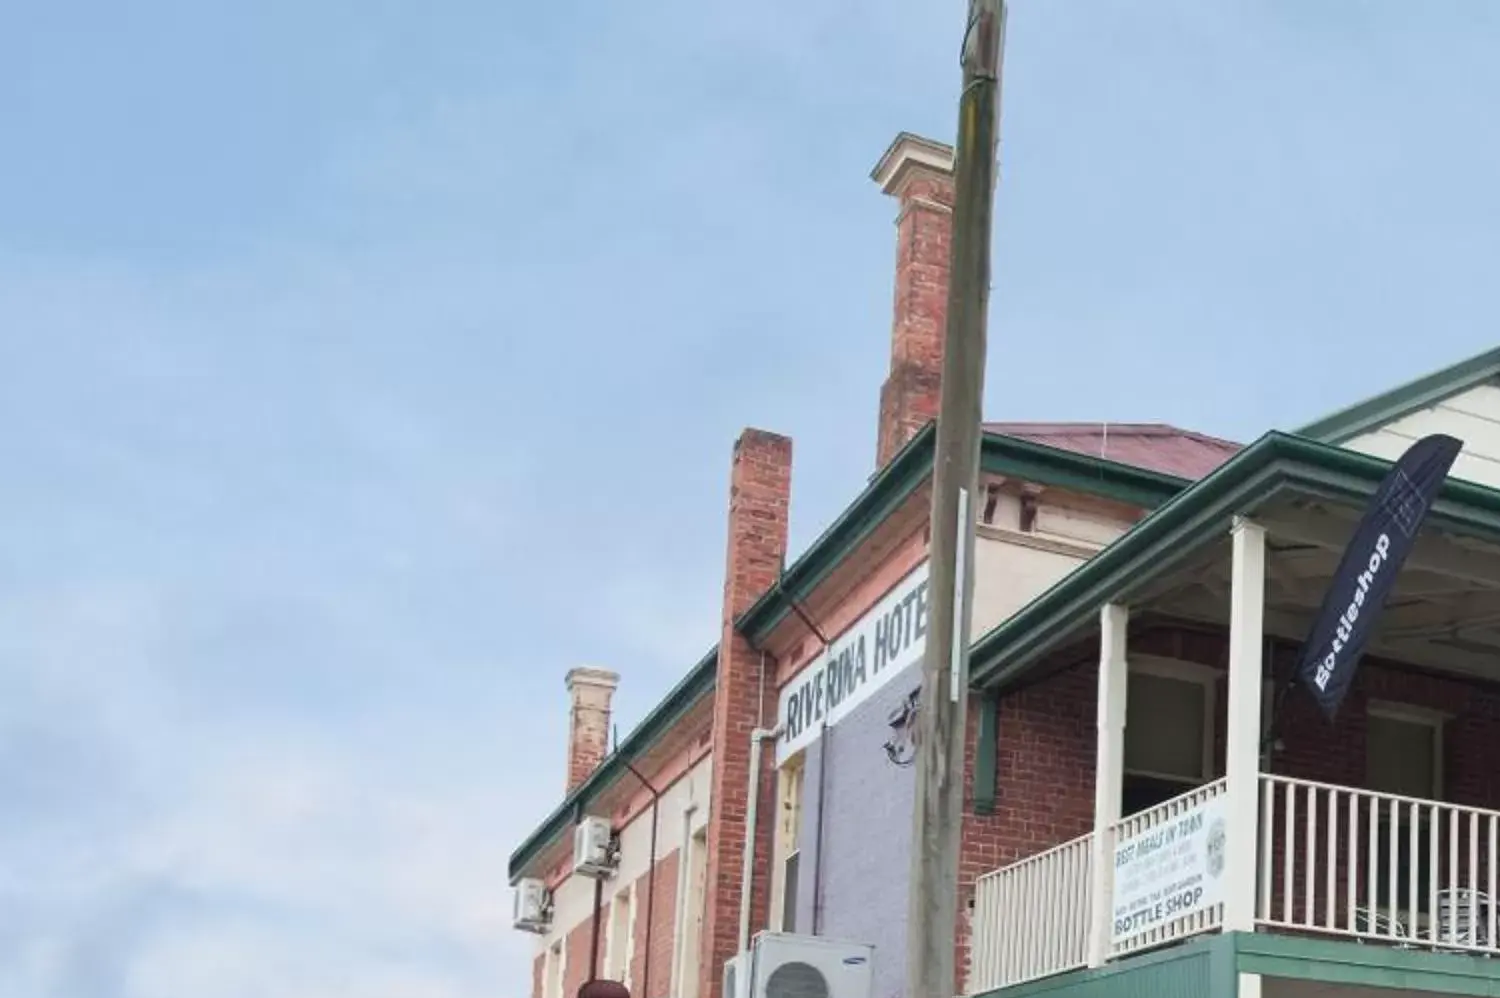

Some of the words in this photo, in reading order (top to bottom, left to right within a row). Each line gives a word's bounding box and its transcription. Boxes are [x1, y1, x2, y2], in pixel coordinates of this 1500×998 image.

[786, 633, 867, 743] RIVERINA
[873, 580, 928, 676] HOTE
[1314, 533, 1390, 691] Bottleshop
[1114, 902, 1163, 936] BOTTLE
[1166, 887, 1203, 917] SHOP
